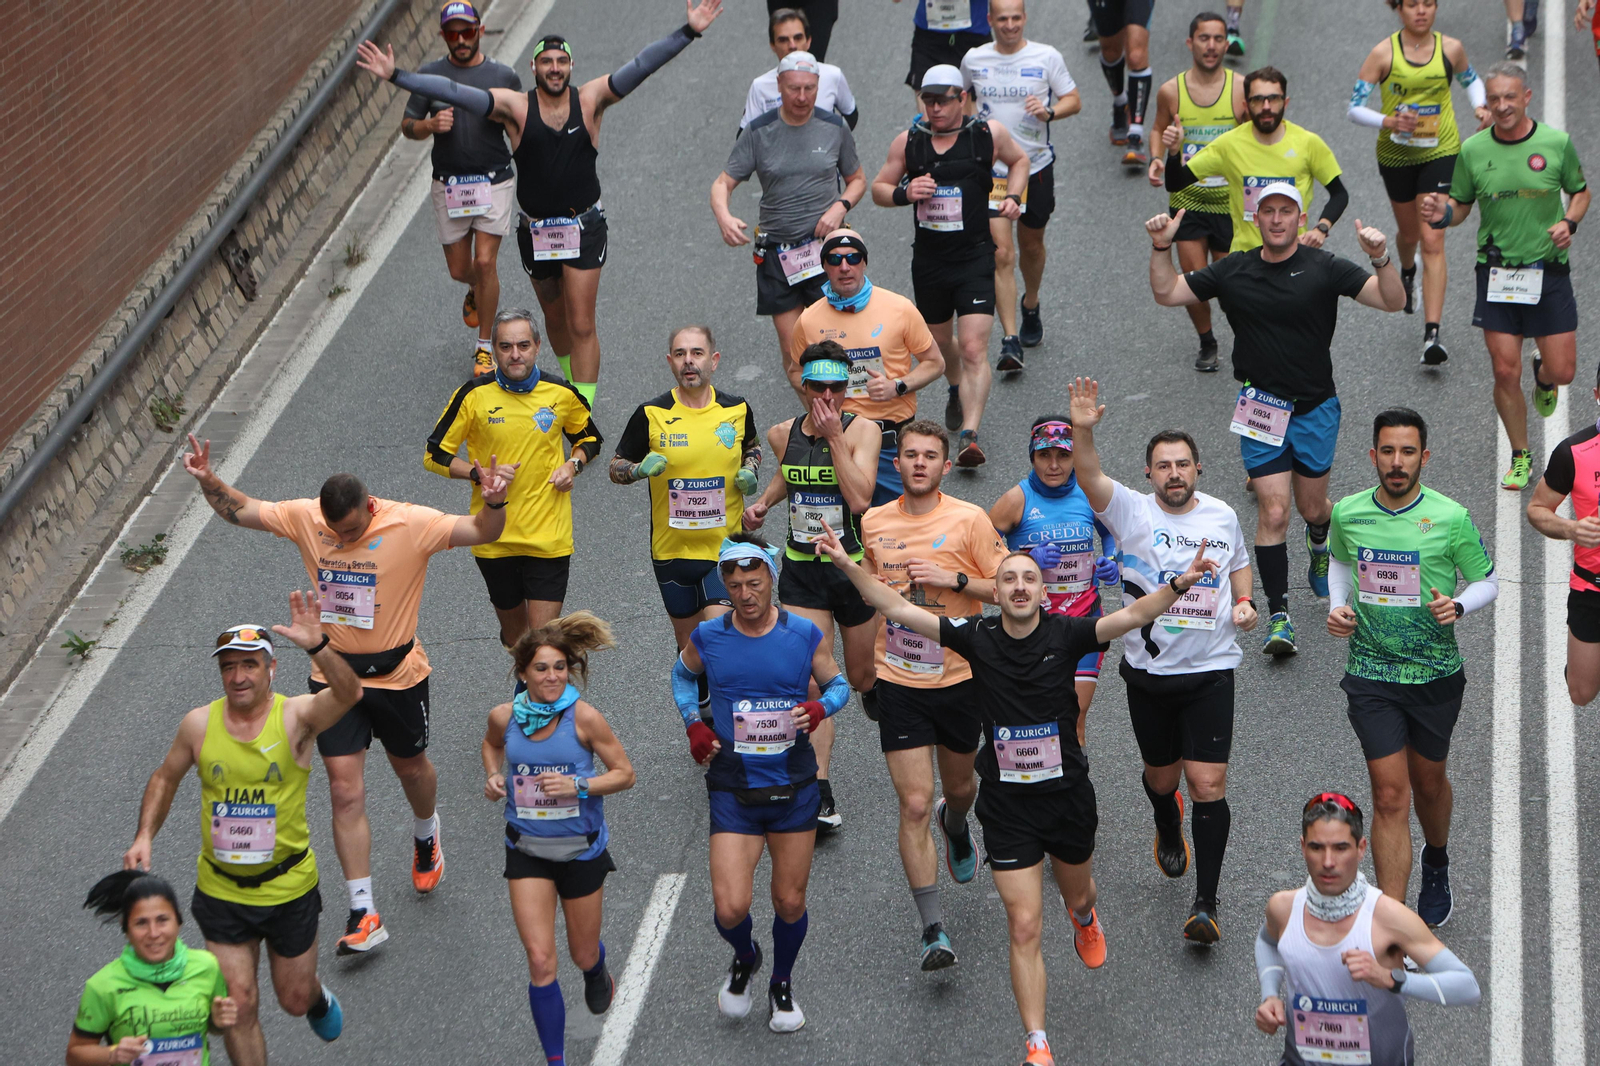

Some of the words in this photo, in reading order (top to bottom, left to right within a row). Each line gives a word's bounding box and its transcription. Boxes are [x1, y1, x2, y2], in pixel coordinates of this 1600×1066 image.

[460, 175, 485, 183] ZURICH
[933, 188, 956, 196] URICH
[546, 217, 573, 226] ZURICH
[811, 362, 840, 375] OTSO
[1257, 392, 1288, 408] ZURICH
[1253, 407, 1271, 420] 6934
[1247, 419, 1272, 432] BRANKO
[687, 480, 719, 489] ZURICH
[687, 497, 707, 506] 7922
[804, 495, 836, 504] ZURICH
[675, 510, 697, 518] ETIOPE
[698, 508, 721, 517] TRIANA
[1348, 518, 1377, 526] Kappa
[1028, 526, 1091, 543] CREDUS
[1060, 543, 1089, 552] ZURICH
[319, 557, 346, 567] Maratón
[1377, 552, 1412, 562] ZURICH
[1059, 561, 1078, 570] 7864
[336, 573, 369, 583] ZURICH
[1056, 574, 1078, 582] MAYTE
[1376, 570, 1398, 581] 6936
[1379, 585, 1397, 594] FALE
[335, 590, 355, 601] 8054
[335, 605, 356, 614] CRIZZY
[1182, 607, 1213, 617] REPSCAN
[902, 637, 923, 649] 6656
[903, 651, 922, 661] LUDO
[755, 700, 791, 710] ZURICH
[756, 719, 778, 729] 7530
[745, 734, 757, 742] JM
[758, 732, 787, 742] ARAGÓN
[1014, 726, 1051, 738] ZURICH
[1015, 746, 1039, 757] 6660
[533, 765, 568, 774] ZURICH
[1015, 761, 1045, 770] MAXIME
[224, 787, 266, 804] LIAM
[534, 799, 558, 807] ALICIA
[230, 806, 269, 816] ZURICH
[231, 842, 251, 850] LIAM
[1316, 1000, 1358, 1013] ZURICH
[157, 1036, 196, 1052] ZURICH
[1305, 1036, 1323, 1047] HIJO
[1325, 1039, 1335, 1048] DE
[1338, 1040, 1360, 1050] JUAN
